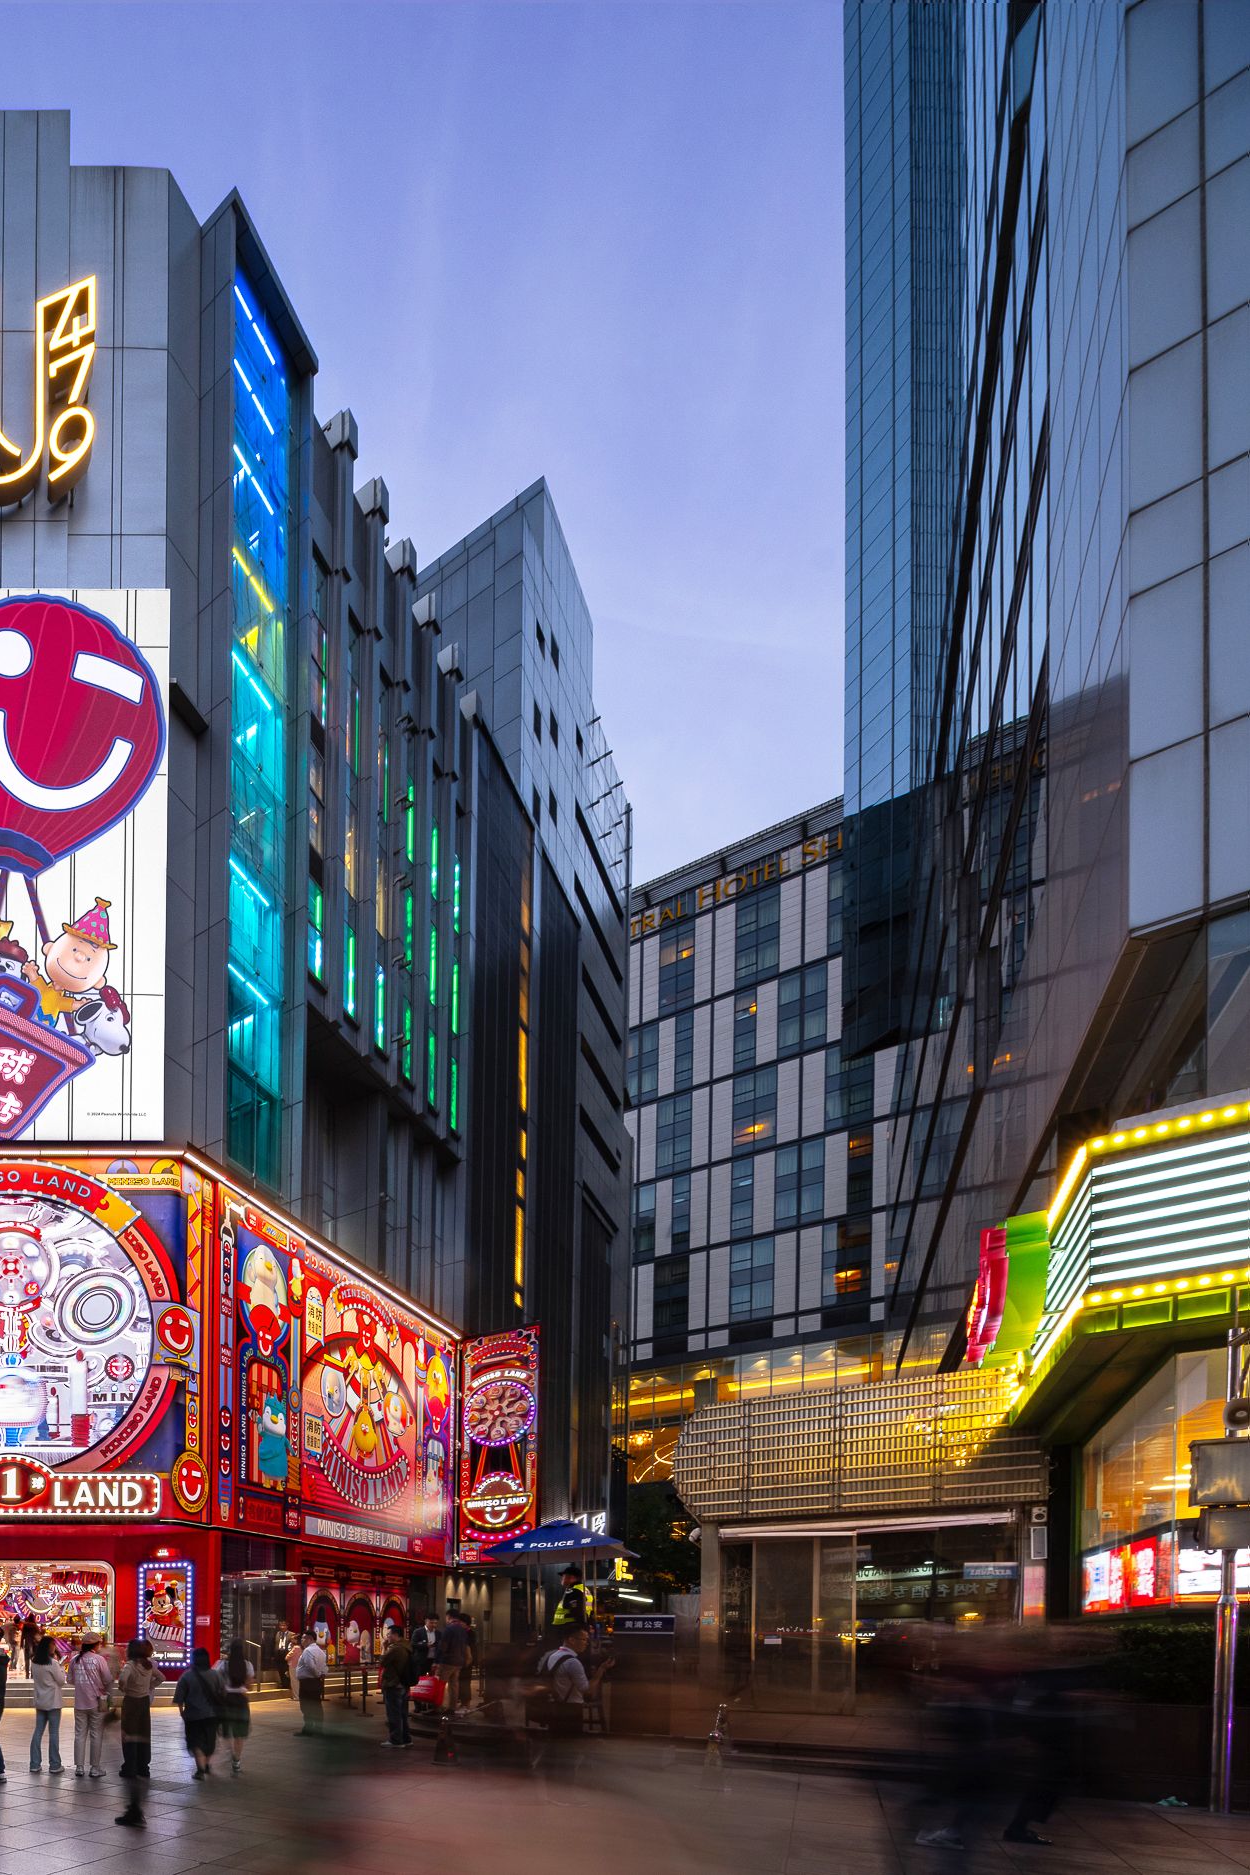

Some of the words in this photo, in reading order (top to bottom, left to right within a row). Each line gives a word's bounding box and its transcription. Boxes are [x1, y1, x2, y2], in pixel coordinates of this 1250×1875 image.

[698, 852, 790, 910] HOTEL
[802, 830, 843, 865] SH
[32, 1172, 92, 1198] LAND
[107, 1177, 150, 1186] MINISO
[152, 1177, 180, 1187] LAND
[144, 1261, 166, 1298] LAND
[221, 1297, 232, 1307] MINI
[341, 1289, 370, 1303] MINISO
[372, 1301, 391, 1325] LAND
[221, 1347, 232, 1357] MINI
[243, 1347, 254, 1368] LAND
[472, 1371, 502, 1388] MINISO
[504, 1370, 527, 1379] LAND
[100, 1412, 145, 1459] MINISO
[140, 1376, 162, 1415] LAND
[307, 1418, 321, 1435] 消防
[31, 1476, 45, 1490] 球
[323, 1448, 368, 1501] MINISO
[372, 1465, 405, 1501] LAND
[1, 1467, 21, 1501] 1
[53, 1481, 142, 1507] LAND
[467, 1499, 499, 1509] MINISO
[501, 1496, 527, 1506] LAND
[288, 1511, 298, 1519] MINI
[318, 1518, 347, 1540] MINISO
[348, 1524, 380, 1546] 全球壹号店
[381, 1531, 400, 1549] LAND
[530, 1540, 574, 1548] POLICE
[625, 1620, 663, 1628] 黄浦公安
